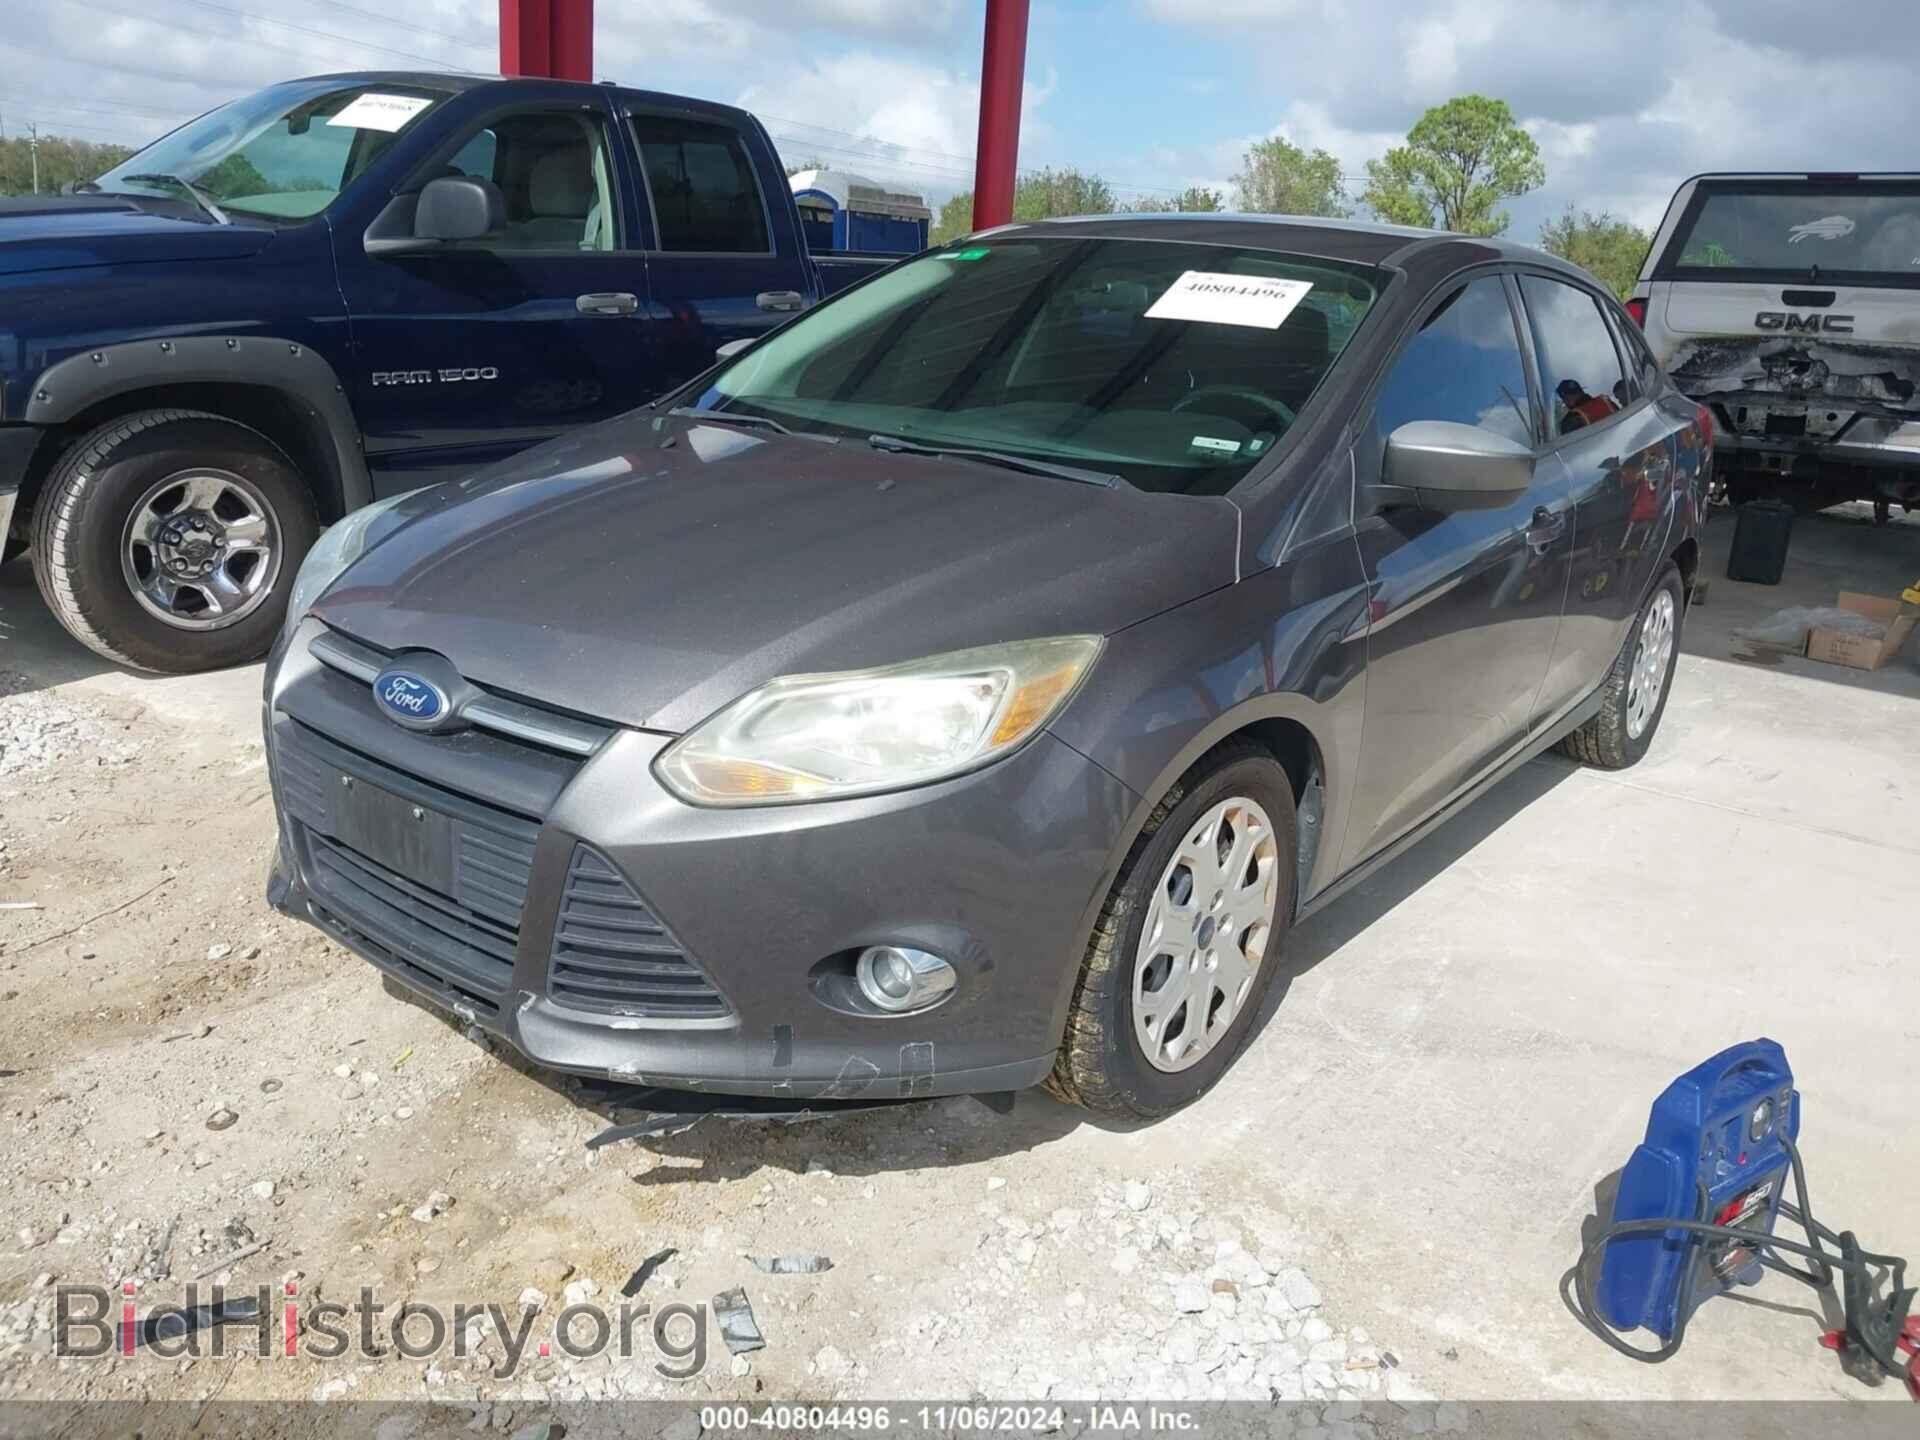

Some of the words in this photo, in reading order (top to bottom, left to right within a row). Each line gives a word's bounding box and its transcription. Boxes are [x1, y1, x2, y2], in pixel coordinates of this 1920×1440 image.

[1185, 282, 1286, 299] 40804496
[1755, 312, 1855, 333] GMC
[372, 371, 432, 386] RAM
[438, 367, 499, 382] 1500
[385, 677, 428, 712] Ford
